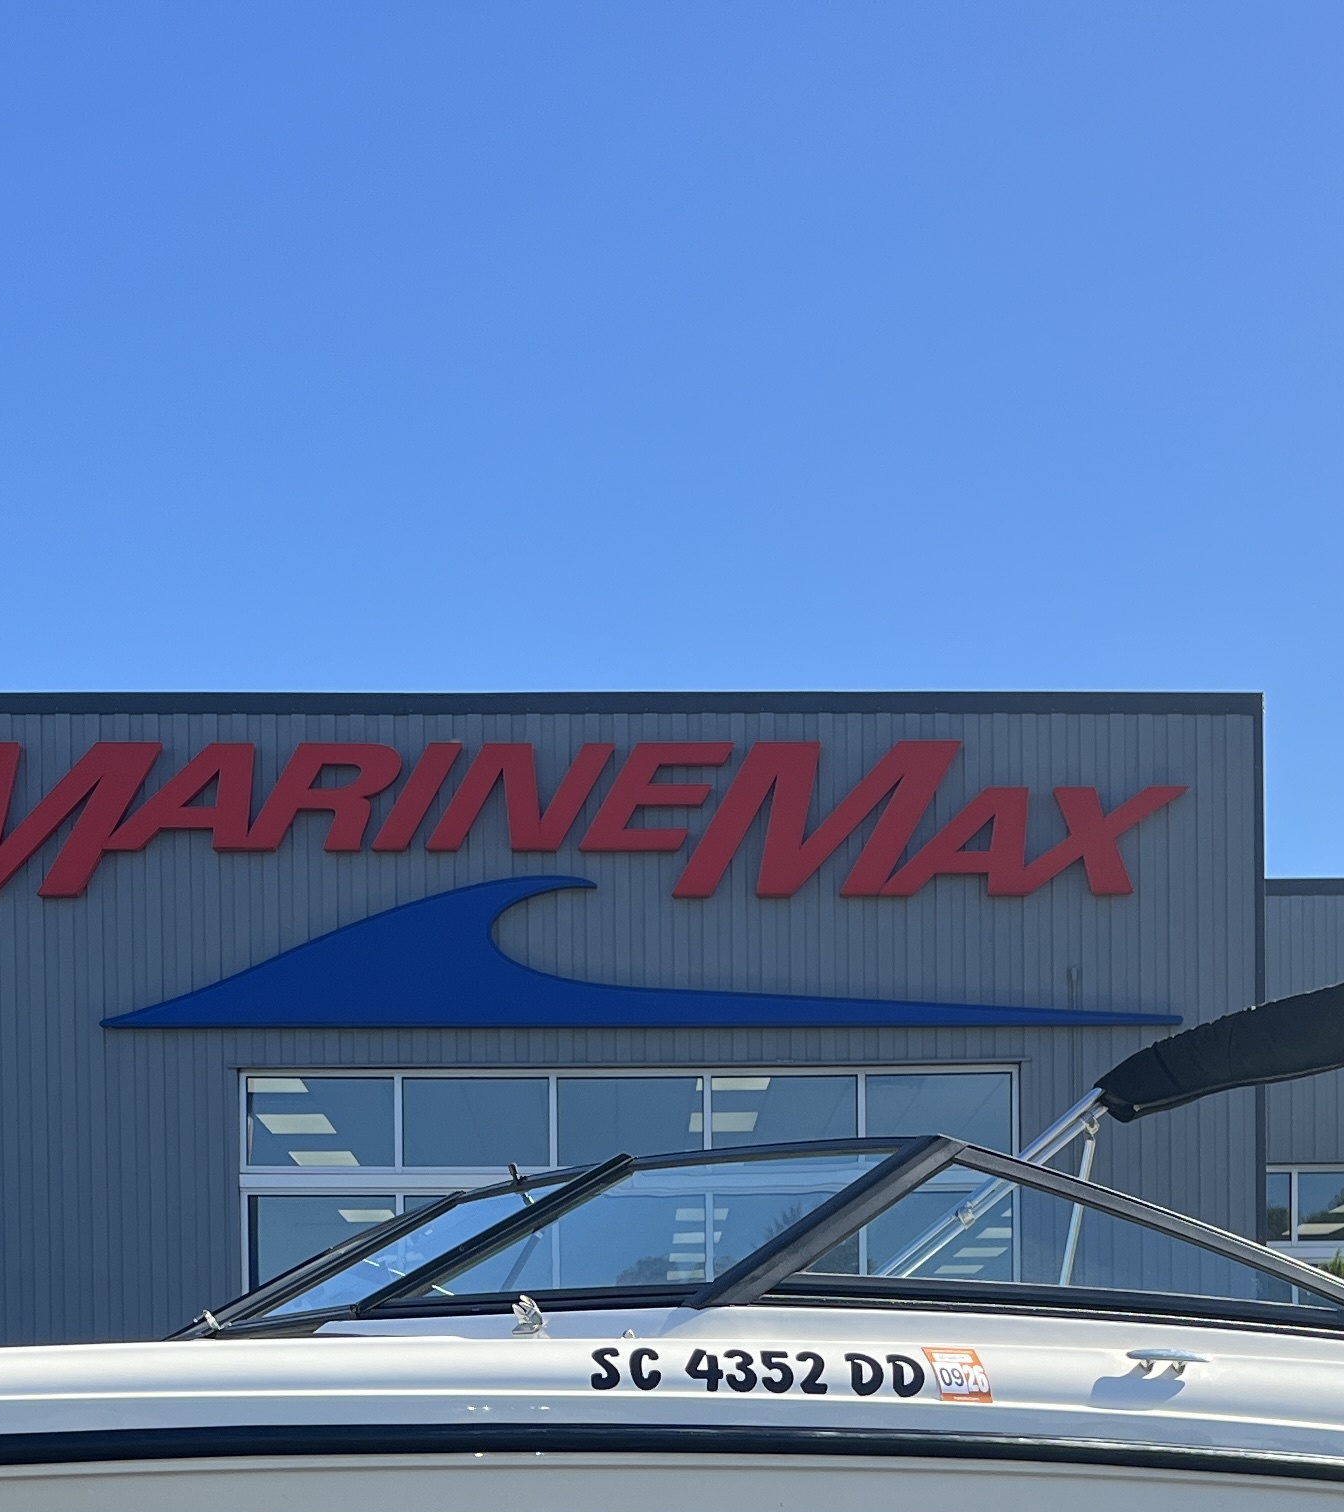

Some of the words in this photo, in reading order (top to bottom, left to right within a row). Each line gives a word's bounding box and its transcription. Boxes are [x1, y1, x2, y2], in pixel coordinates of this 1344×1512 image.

[590, 1347, 661, 1391] SC
[684, 1348, 829, 1395] 4352
[843, 1352, 925, 1398] DD
[939, 1367, 965, 1387] 09
